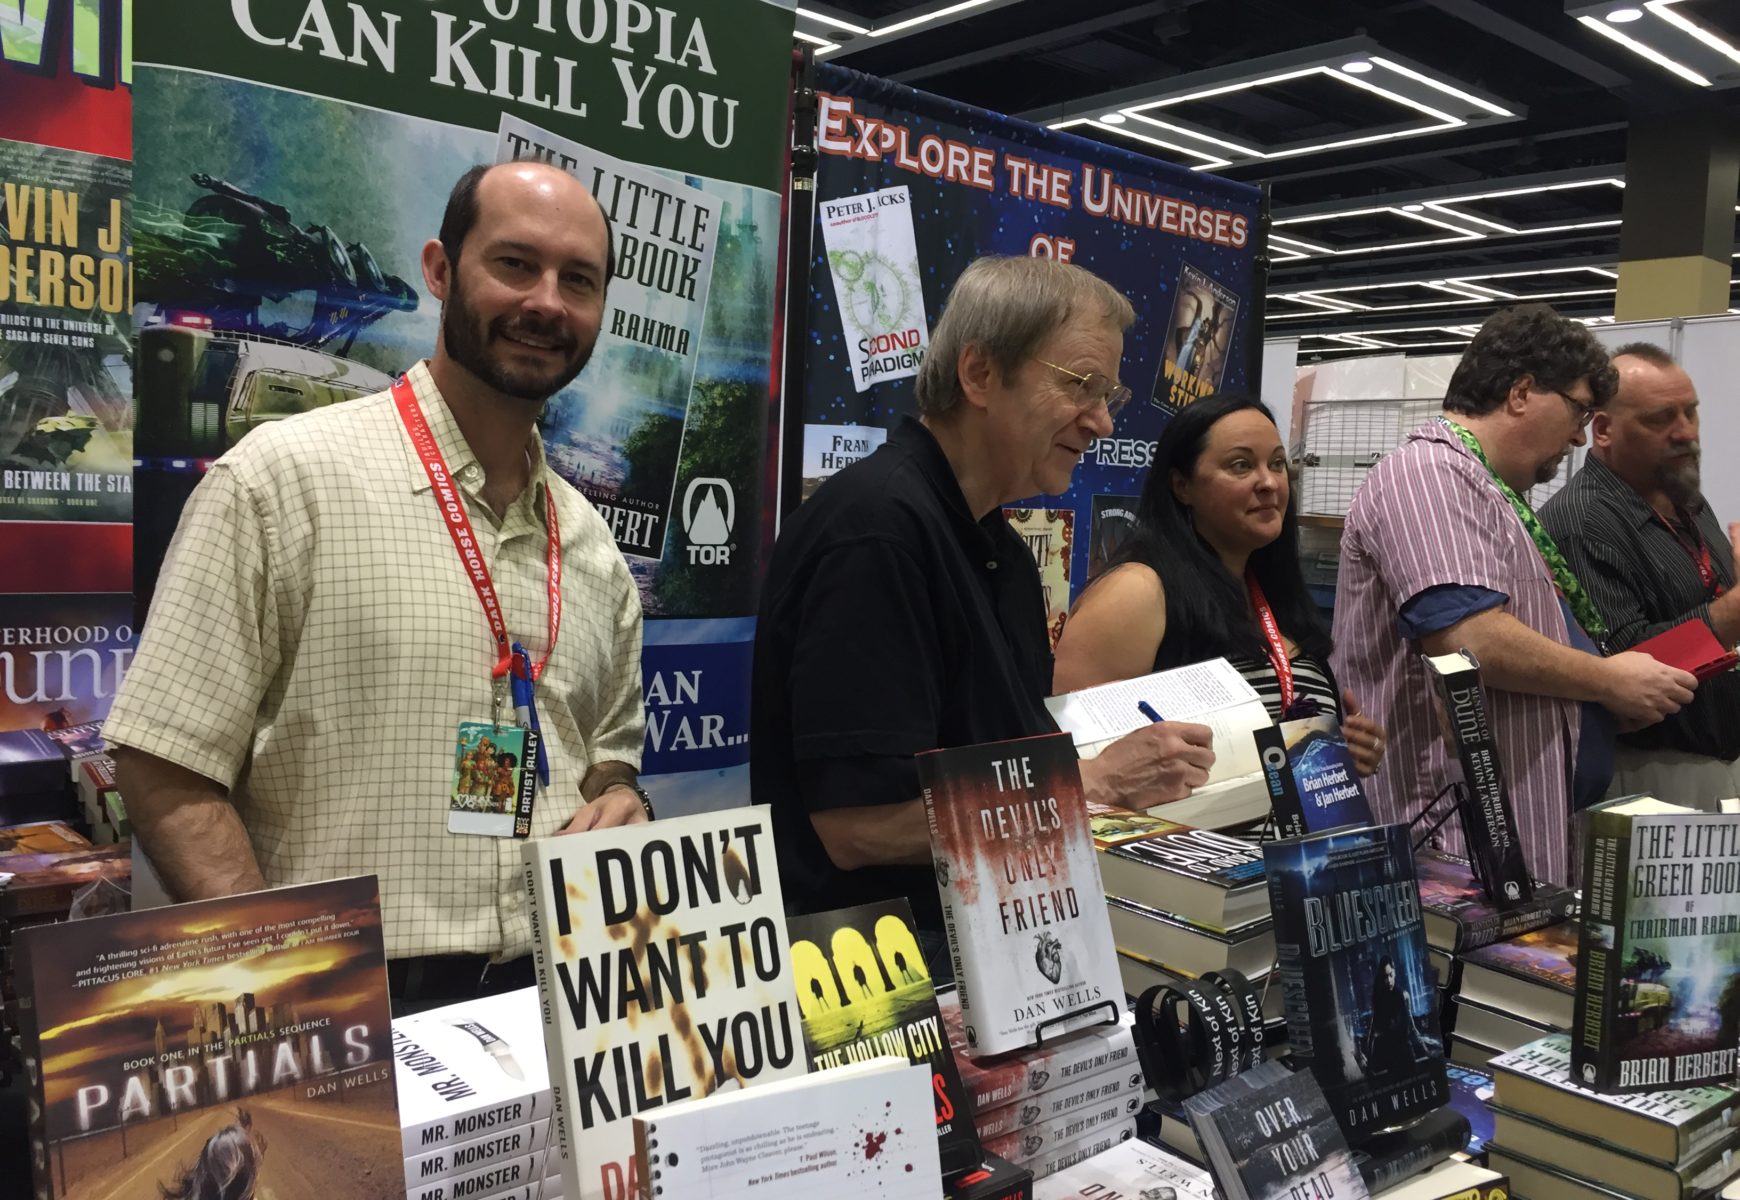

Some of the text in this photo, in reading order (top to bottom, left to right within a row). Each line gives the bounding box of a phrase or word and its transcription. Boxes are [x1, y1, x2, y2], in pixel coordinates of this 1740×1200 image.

[230, 0, 401, 73] CAN
[430, 10, 587, 117] KILL
[612, 57, 740, 149] YOU
[817, 92, 1248, 248] EXPLORE THE UNIVERSES
[4, 182, 79, 248] VIN
[826, 203, 864, 219] PETER
[613, 233, 702, 302] BOOK
[5, 329, 95, 348] SAGA OF SEVEN SUNS
[33, 317, 102, 335] IN THE UNIVERSE
[610, 308, 691, 356] RAHMA
[4, 470, 101, 492] BETWEEN THE
[621, 497, 661, 510] AUTHOR
[429, 461, 503, 633] DARK HORSE COMICS
[686, 545, 730, 565] TOR
[0, 626, 109, 646] ERHOOD
[1451, 688, 1482, 745] DUNE
[525, 731, 538, 771] ALLEY
[1262, 746, 1286, 798] Ocean
[521, 771, 535, 814] ARTIST
[991, 756, 1035, 793] THE
[1302, 772, 1325, 793] Brian
[1323, 768, 1349, 787] Herbert
[1322, 784, 1360, 808] Jan Herbert
[1480, 749, 1507, 827] BRIAN HERBERT
[923, 787, 939, 835] DAN WELLS
[980, 797, 1062, 841] DEVIL'S
[1470, 752, 1502, 848] KEVIN ANDERSON
[1636, 824, 1676, 860] THE
[549, 823, 763, 936] I DON'T
[1003, 845, 1058, 884] ONLY
[1633, 861, 1693, 898] GREEN
[999, 887, 1081, 935] FRIEND
[1304, 879, 1421, 958] BLUESCREEN
[1630, 917, 1697, 940] CHAIRMAN
[1685, 900, 1695, 914] OF
[76, 967, 92, 978] and
[92, 959, 137, 975] frightening
[138, 954, 165, 966] visions
[242, 936, 260, 946] seen
[107, 949, 138, 961] thrilling
[159, 938, 199, 952] adrenaline
[221, 931, 238, 941] with
[264, 924, 277, 932] the
[278, 920, 296, 930] most
[297, 913, 336, 927] compelling
[944, 904, 970, 1010] THE DEVIL'S ONLY FRIEND
[161, 962, 180, 972] New
[182, 958, 201, 969] York
[530, 911, 553, 1026] WANT KILL YOU
[555, 916, 781, 1030] WANT TO
[1014, 985, 1101, 1022] DAN WELLS
[1215, 995, 1240, 1044] of Kin
[1244, 994, 1264, 1043] of Kin
[1584, 949, 1606, 1053] BRIAN HERBERT
[123, 1017, 332, 1072] BOOK ONE IN THE PARTIALS SEQUENCE
[907, 1015, 943, 1058] CITY
[1188, 989, 1224, 1077] Next of Kin
[76, 1024, 371, 1132] PARTIALS
[307, 1068, 389, 1099] DAN WELLS
[573, 1000, 794, 1130] KILL YOU
[977, 1046, 1128, 1108] DAN WELLS THE DEVIL'S ONLY FRIEND
[1619, 1048, 1737, 1088] BRIAN HERBERT
[431, 1073, 477, 1102] MR.
[1052, 1099, 1063, 1112] THE
[1064, 1092, 1086, 1109] DEVIL'S
[1086, 1087, 1100, 1101] ONLY
[1100, 1081, 1120, 1096] FRIEND
[1349, 1103, 1380, 1127] DAN
[1391, 1080, 1439, 1112] WELLS
[421, 1103, 522, 1146] MR. MONSTER
[553, 1086, 569, 1160] DAN WELLS
[1054, 1106, 1118, 1142] THE DEVIL'S ONLY FRIEND
[1255, 1097, 1302, 1138] OVER
[420, 1133, 521, 1178] MR. MONSTER
[1045, 1162, 1056, 1175] THE
[1077, 1147, 1092, 1164] ONLY
[1092, 1138, 1111, 1154] FRIEND
[1271, 1132, 1320, 1177] YOUR
[453, 1164, 520, 1199] MONSTER
